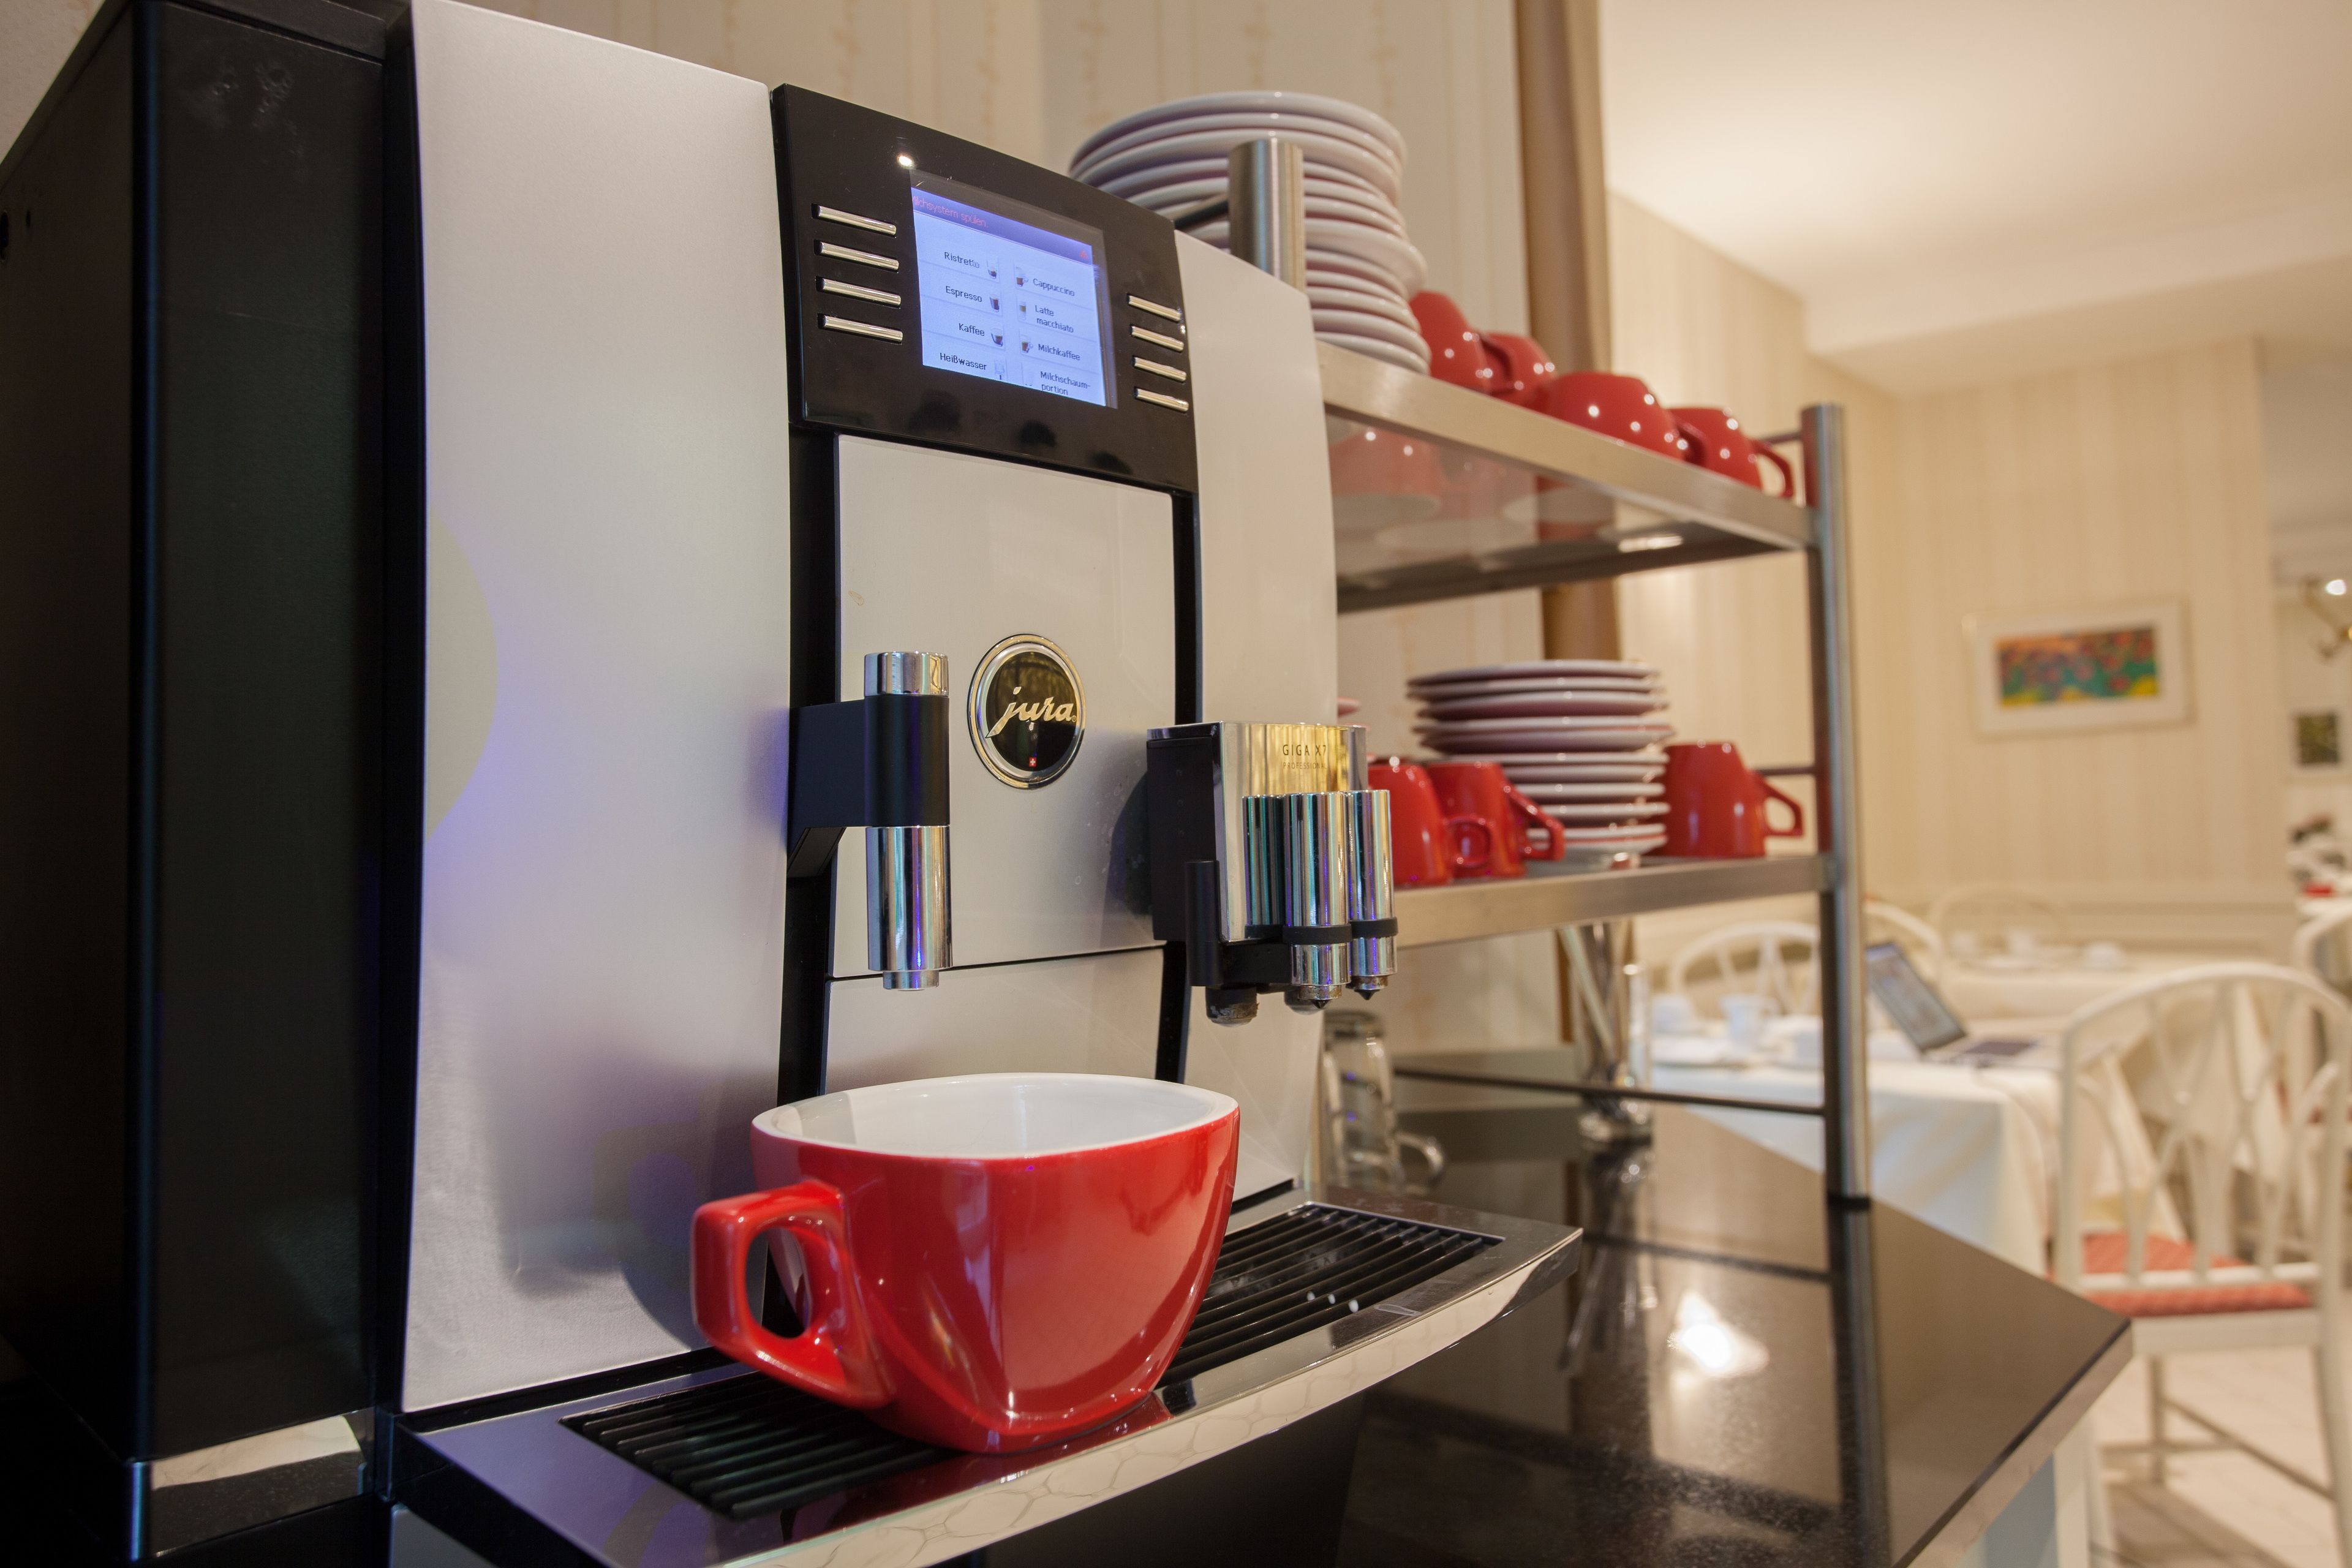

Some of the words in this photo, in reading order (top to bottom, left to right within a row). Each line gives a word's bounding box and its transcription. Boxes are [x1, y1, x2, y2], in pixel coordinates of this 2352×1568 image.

[945, 285, 982, 303] Espresso
[1033, 278, 1076, 296] Cappuccino
[1035, 305, 1054, 316] Latte
[959, 323, 985, 336] Kaffee
[1036, 317, 1074, 333] macchiato
[1038, 344, 1080, 361] Milchkaffee
[940, 352, 987, 371] Heißwasser
[1040, 371, 1091, 390] Milchschaum-
[1041, 384, 1068, 396] portion
[985, 687, 1074, 739] jura
[1282, 744, 1310, 756] GIGA
[1315, 744, 1327, 756] X7
